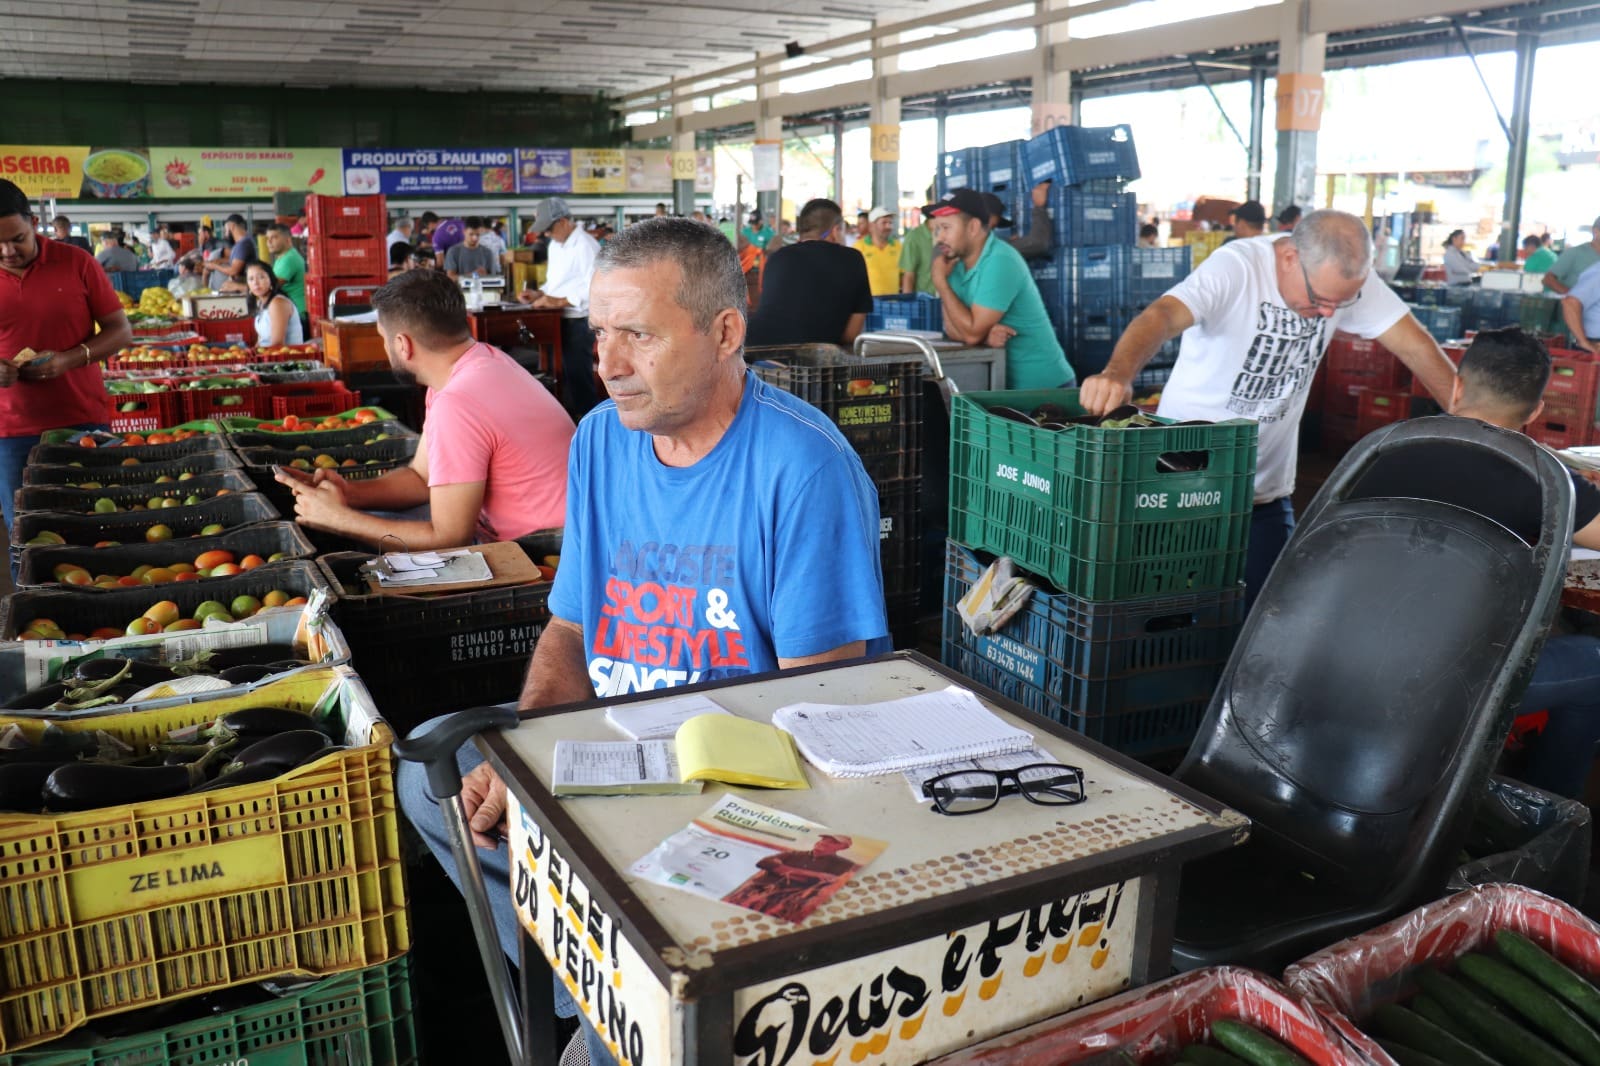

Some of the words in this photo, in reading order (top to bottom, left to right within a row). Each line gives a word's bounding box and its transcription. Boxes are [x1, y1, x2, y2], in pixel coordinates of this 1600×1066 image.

[1296, 90, 1323, 116] 07
[880, 133, 899, 151] 05
[0, 156, 71, 174] SEIRA
[352, 153, 437, 165] PRODUTOS
[677, 160, 694, 173] 03
[996, 464, 1019, 482] JOSE
[1022, 471, 1051, 495] JUNIOR
[1177, 491, 1222, 508] JUNIOR
[602, 576, 698, 627] SPORT
[705, 588, 741, 630] &
[451, 630, 505, 648] REINALDO
[592, 617, 749, 669] LIFESTYLE
[717, 808, 758, 827] Rural
[726, 801, 811, 833] Previdência
[701, 846, 730, 860] 20
[130, 871, 160, 893] ZE
[166, 861, 224, 886] LIMA
[516, 860, 538, 921] DO
[553, 906, 644, 1066] PEPINO
[733, 982, 932, 1066] Deus
